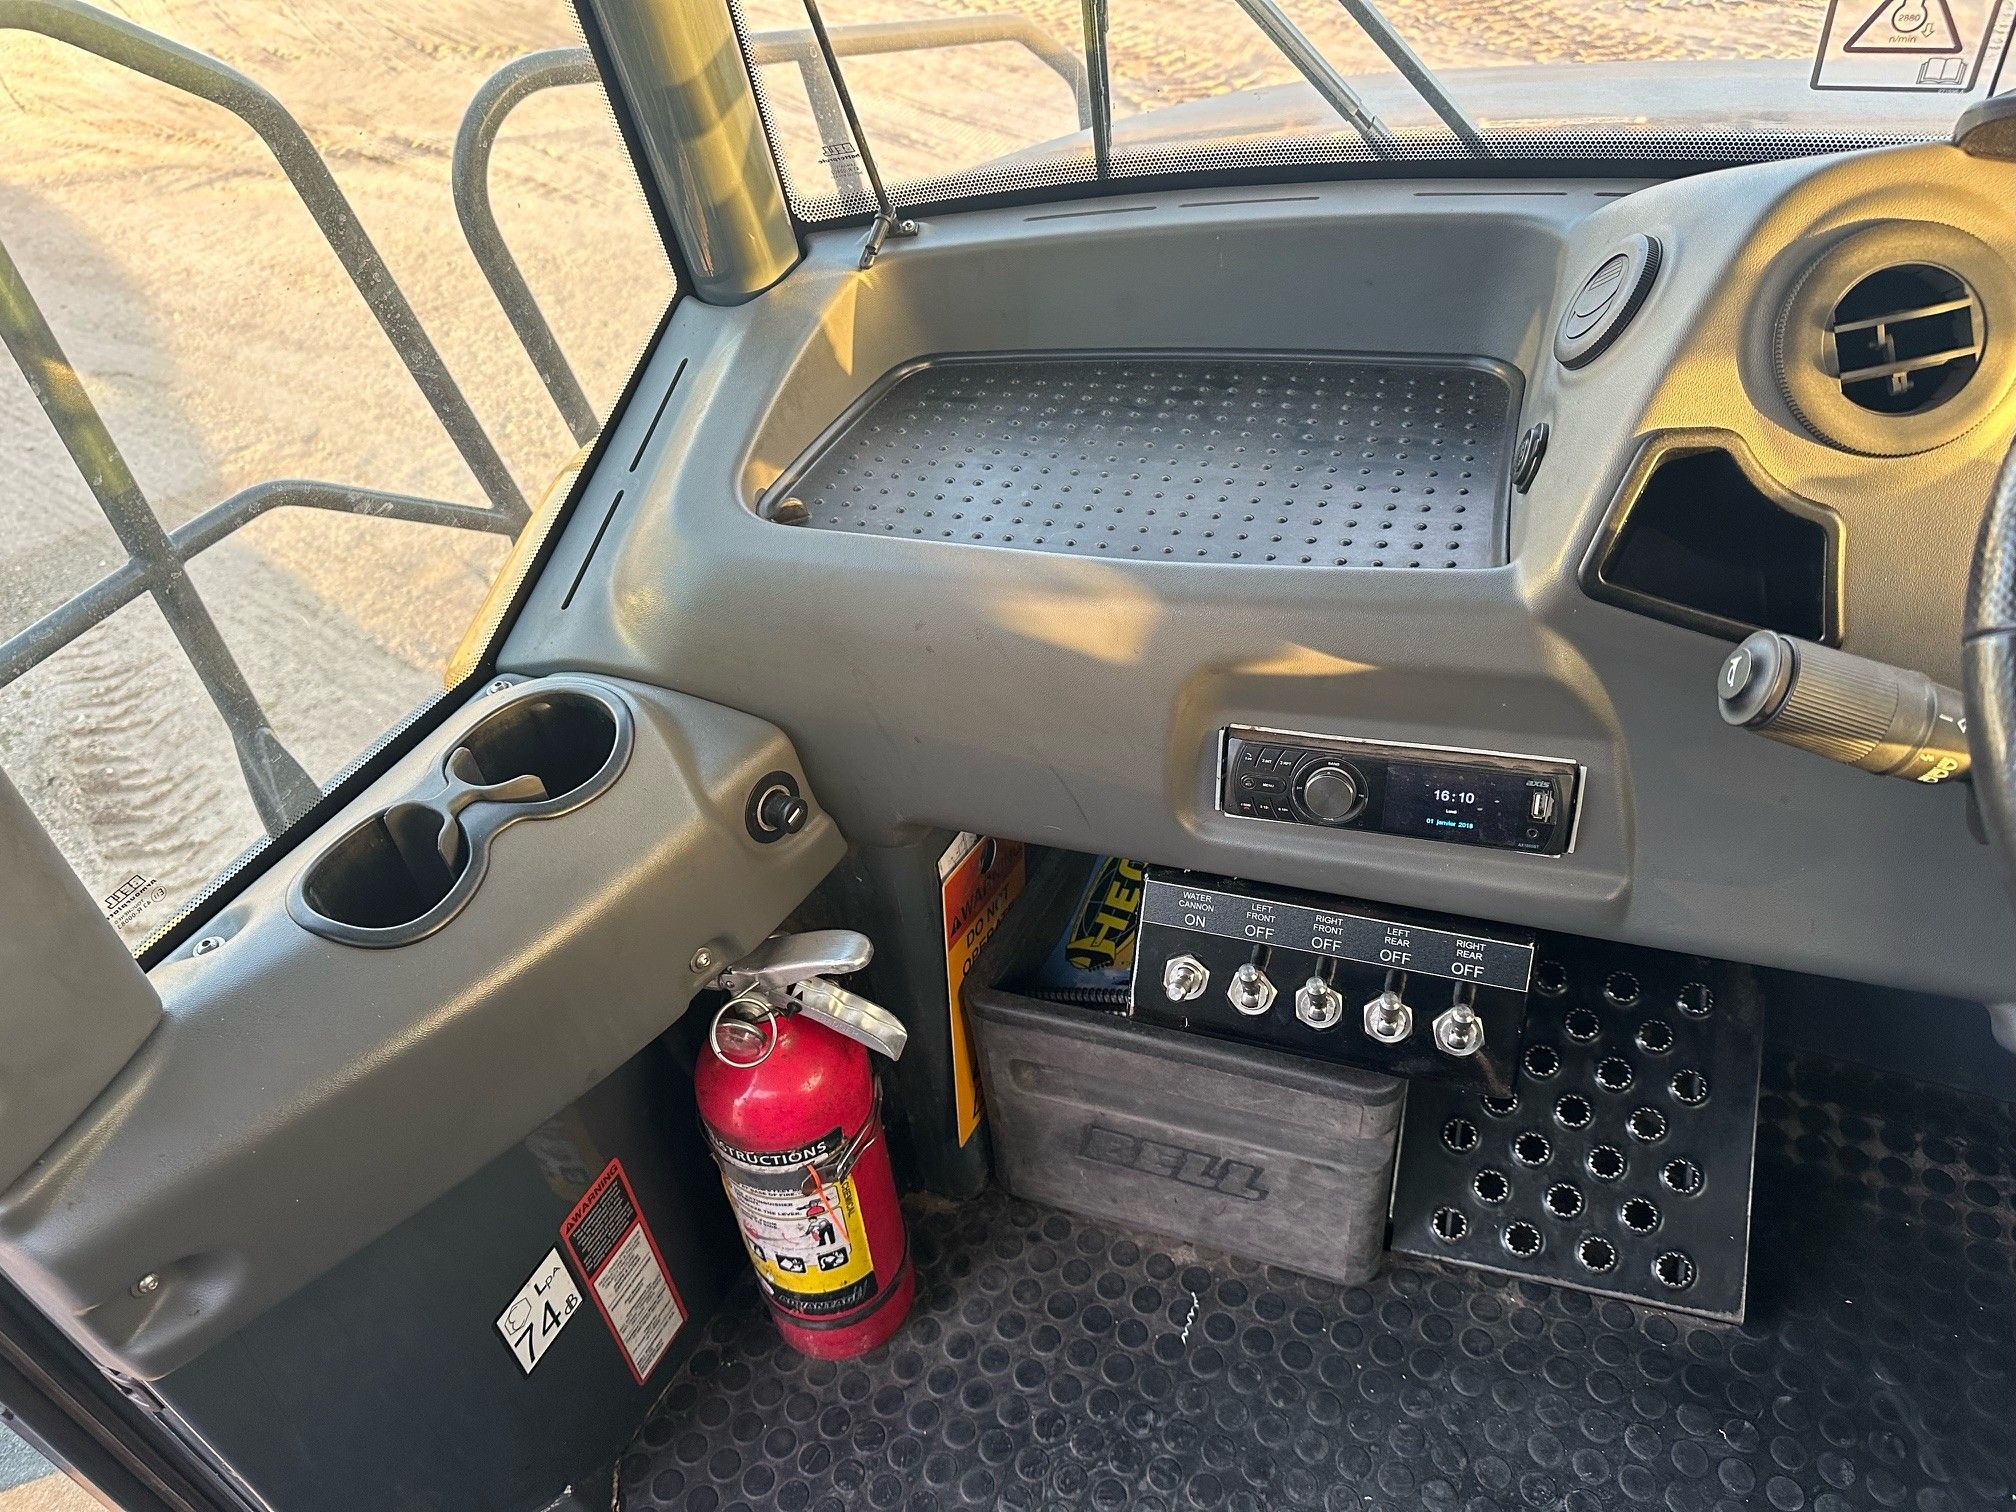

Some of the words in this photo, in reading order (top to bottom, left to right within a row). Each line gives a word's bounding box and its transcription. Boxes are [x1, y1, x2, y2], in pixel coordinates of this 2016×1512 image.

[1888, 35, 1918, 43] n/min
[1434, 789, 1475, 804] 16:10
[1183, 891, 1212, 903] WATER
[1178, 900, 1215, 913] CANNON
[1251, 903, 1273, 913] LEFT
[1184, 913, 1206, 928] ON
[1246, 911, 1276, 923] FRONT
[1315, 914, 1344, 926] RIGHT
[966, 917, 984, 949] DO
[1244, 924, 1275, 940] OFF
[1313, 923, 1344, 936] FRONT
[1386, 927, 1411, 938] LEFT
[1311, 936, 1343, 952] OFF
[1384, 936, 1410, 948] REAR
[1456, 939, 1487, 952] RIGHT
[1379, 949, 1412, 965] OFF
[1456, 949, 1483, 961] REAR
[1451, 962, 1485, 978] OFF
[571, 1163, 619, 1224] WARNING
[514, 1300, 562, 1363] 74
[564, 1293, 579, 1316] dB
